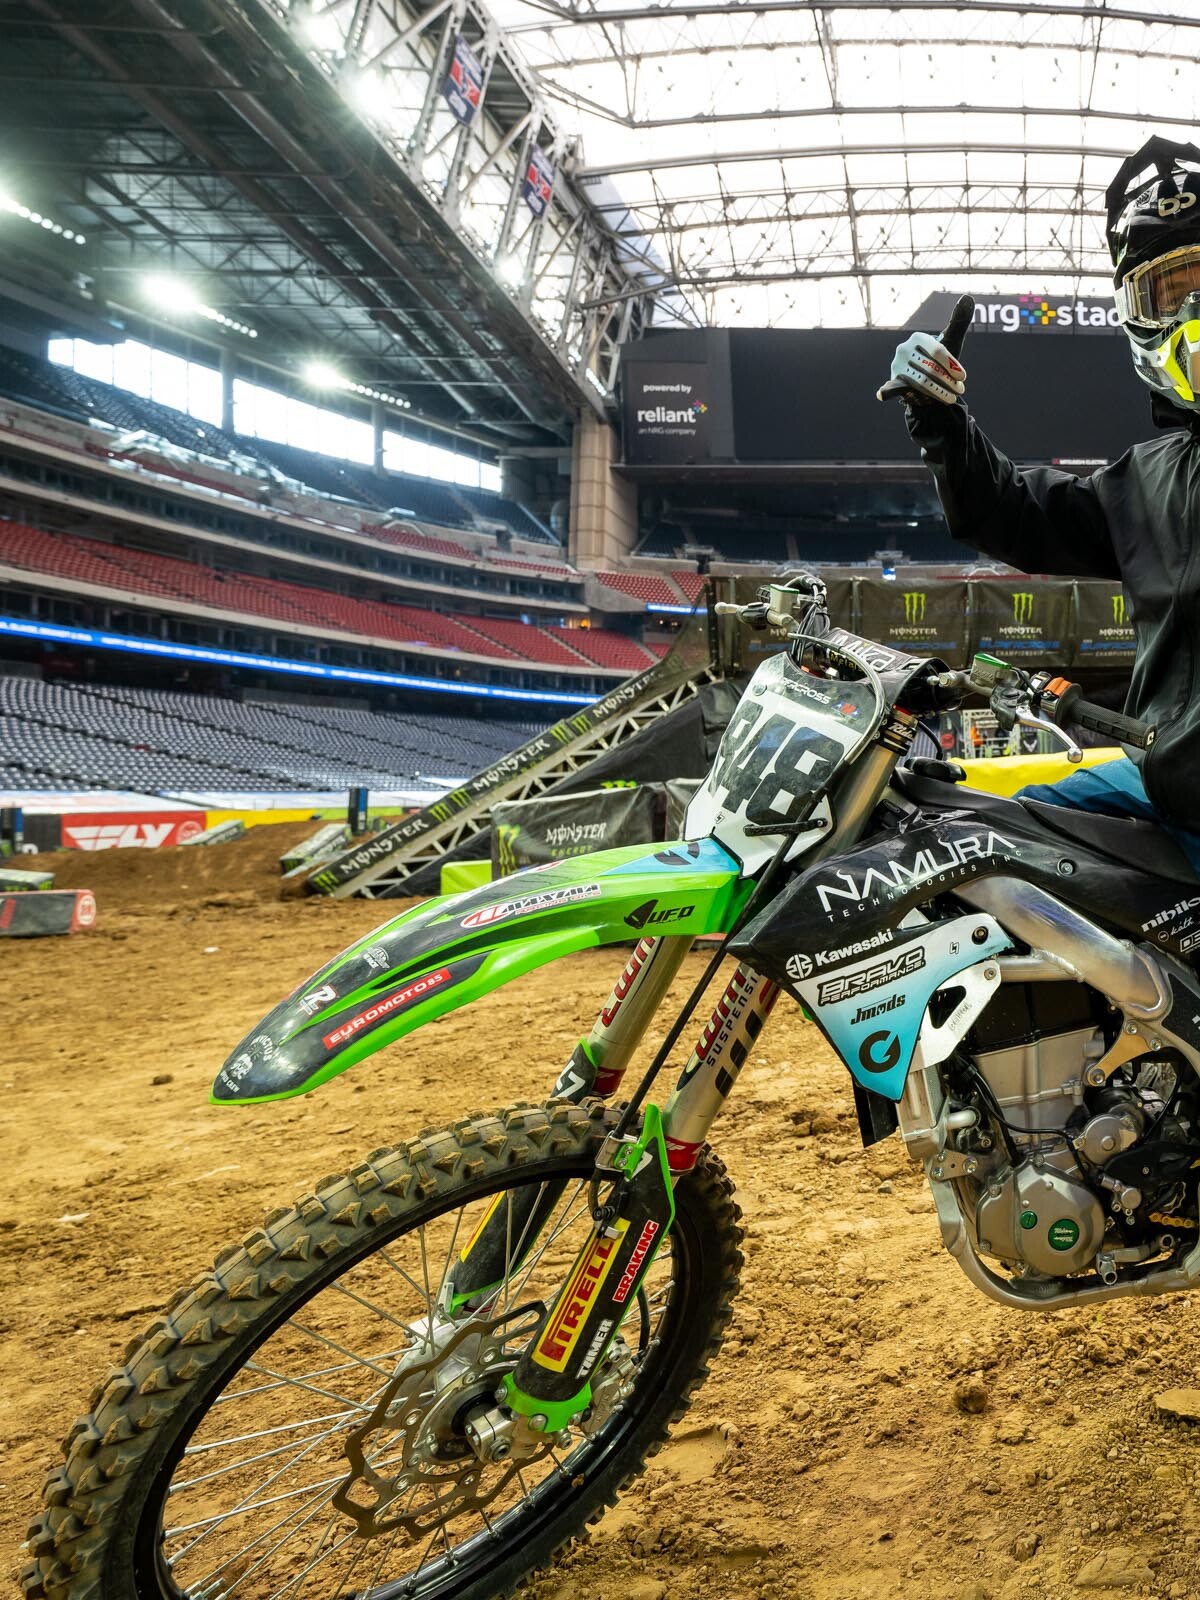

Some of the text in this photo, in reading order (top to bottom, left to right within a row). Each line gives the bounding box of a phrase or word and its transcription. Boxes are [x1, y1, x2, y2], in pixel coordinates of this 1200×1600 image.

[974, 303, 1020, 332] nrg
[643, 384, 692, 394] powered by
[637, 406, 696, 423] reliant
[665, 428, 696, 436] company
[889, 627, 938, 636] MONSTER
[999, 626, 1042, 635] MONSTER
[1099, 628, 1135, 637] MONSTE
[472, 738, 551, 793] MONSTER
[65, 823, 176, 851] FLY
[340, 818, 430, 875] MONSTER
[545, 822, 607, 846] MONSTER
[816, 831, 1017, 912] NAMURA
[827, 850, 1022, 923] TECHNOLOGIES INC
[647, 905, 696, 924] UFO
[815, 928, 893, 967] Kawasaki
[820, 947, 925, 997] BRAVO
[706, 973, 761, 1067] SUSPENSI
[612, 1220, 659, 1303] BRAKING
[539, 1237, 615, 1362] PIRELL
